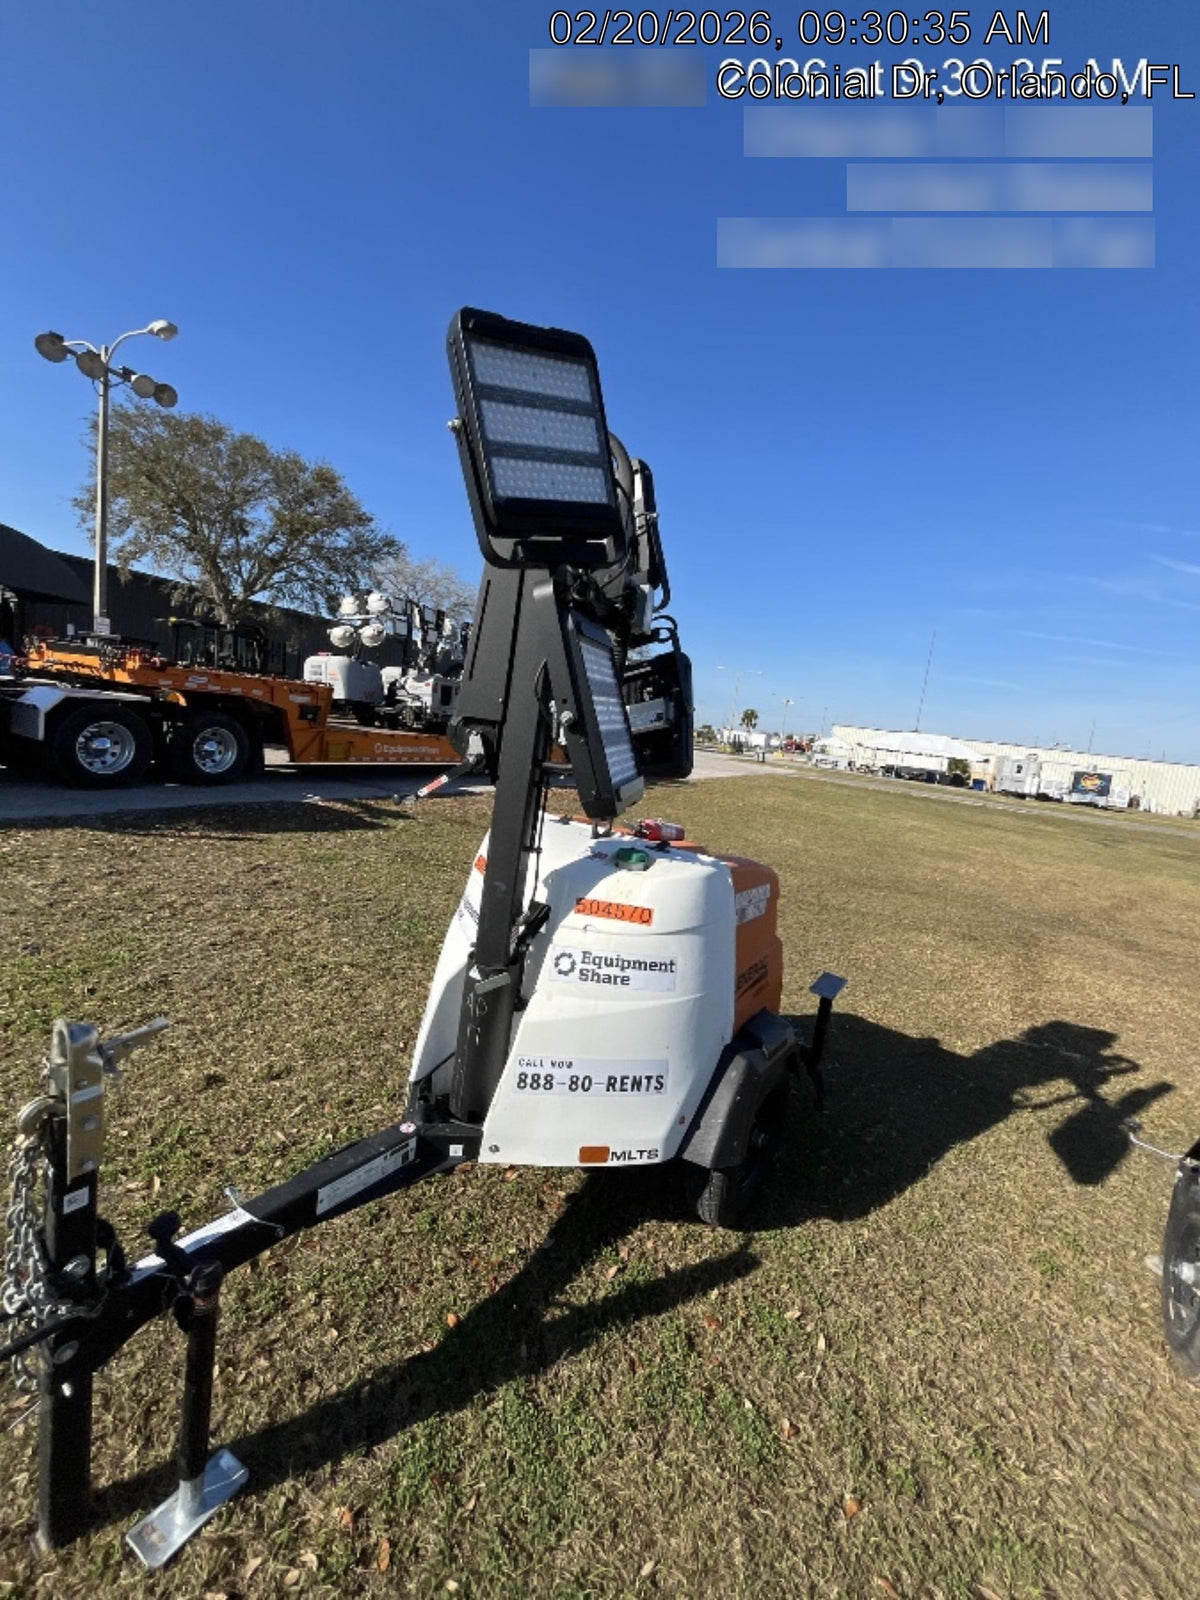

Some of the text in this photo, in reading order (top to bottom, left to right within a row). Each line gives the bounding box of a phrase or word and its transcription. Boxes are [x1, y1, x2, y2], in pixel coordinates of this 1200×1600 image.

[580, 951, 677, 974] Equipment
[578, 968, 631, 986] Share
[518, 1057, 574, 1070] CALL NOW
[516, 1071, 665, 1093] 888-80-RENTS
[610, 1148, 660, 1162] MLTS
